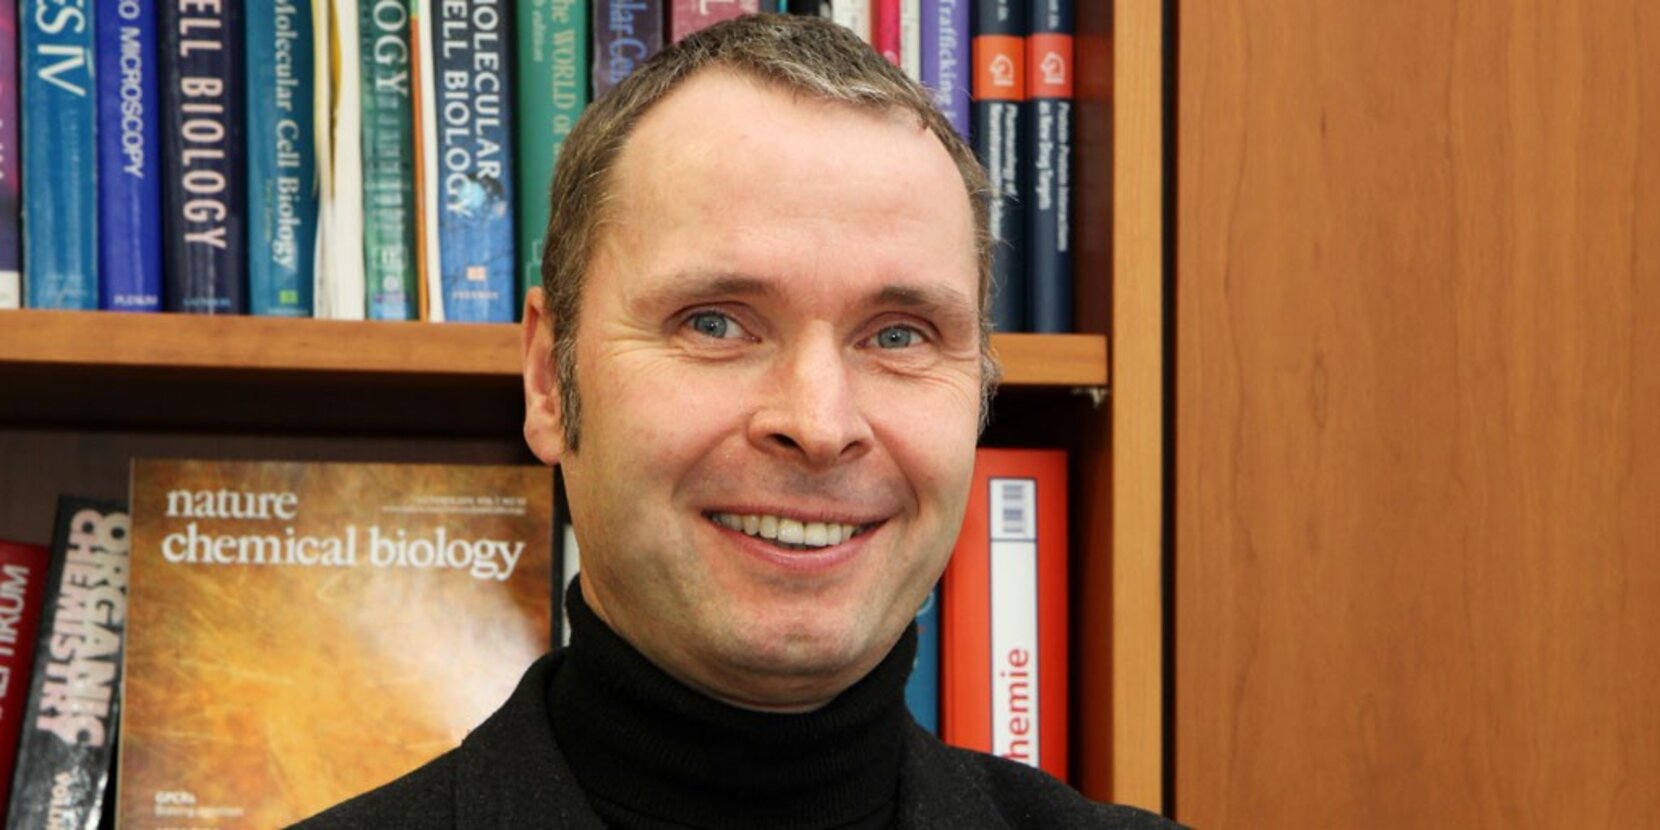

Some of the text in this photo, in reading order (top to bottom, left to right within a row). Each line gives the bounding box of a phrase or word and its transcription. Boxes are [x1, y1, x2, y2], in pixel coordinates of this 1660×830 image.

[118, 0, 143, 179] O MICROSCOPY
[472, 0, 502, 180] OLECULAR
[552, 29, 577, 110] WORLD
[181, 76, 226, 249] BIOLOGY
[276, 119, 300, 168] Cell
[444, 70, 474, 219] BIOLOGY
[272, 176, 301, 273] Biology
[161, 523, 525, 581] chemical biology
[165, 488, 298, 521] nature
[36, 508, 102, 740] CHEMISTRY
[74, 511, 130, 747] ORGANIC
[1000, 648, 1029, 759] hemie
